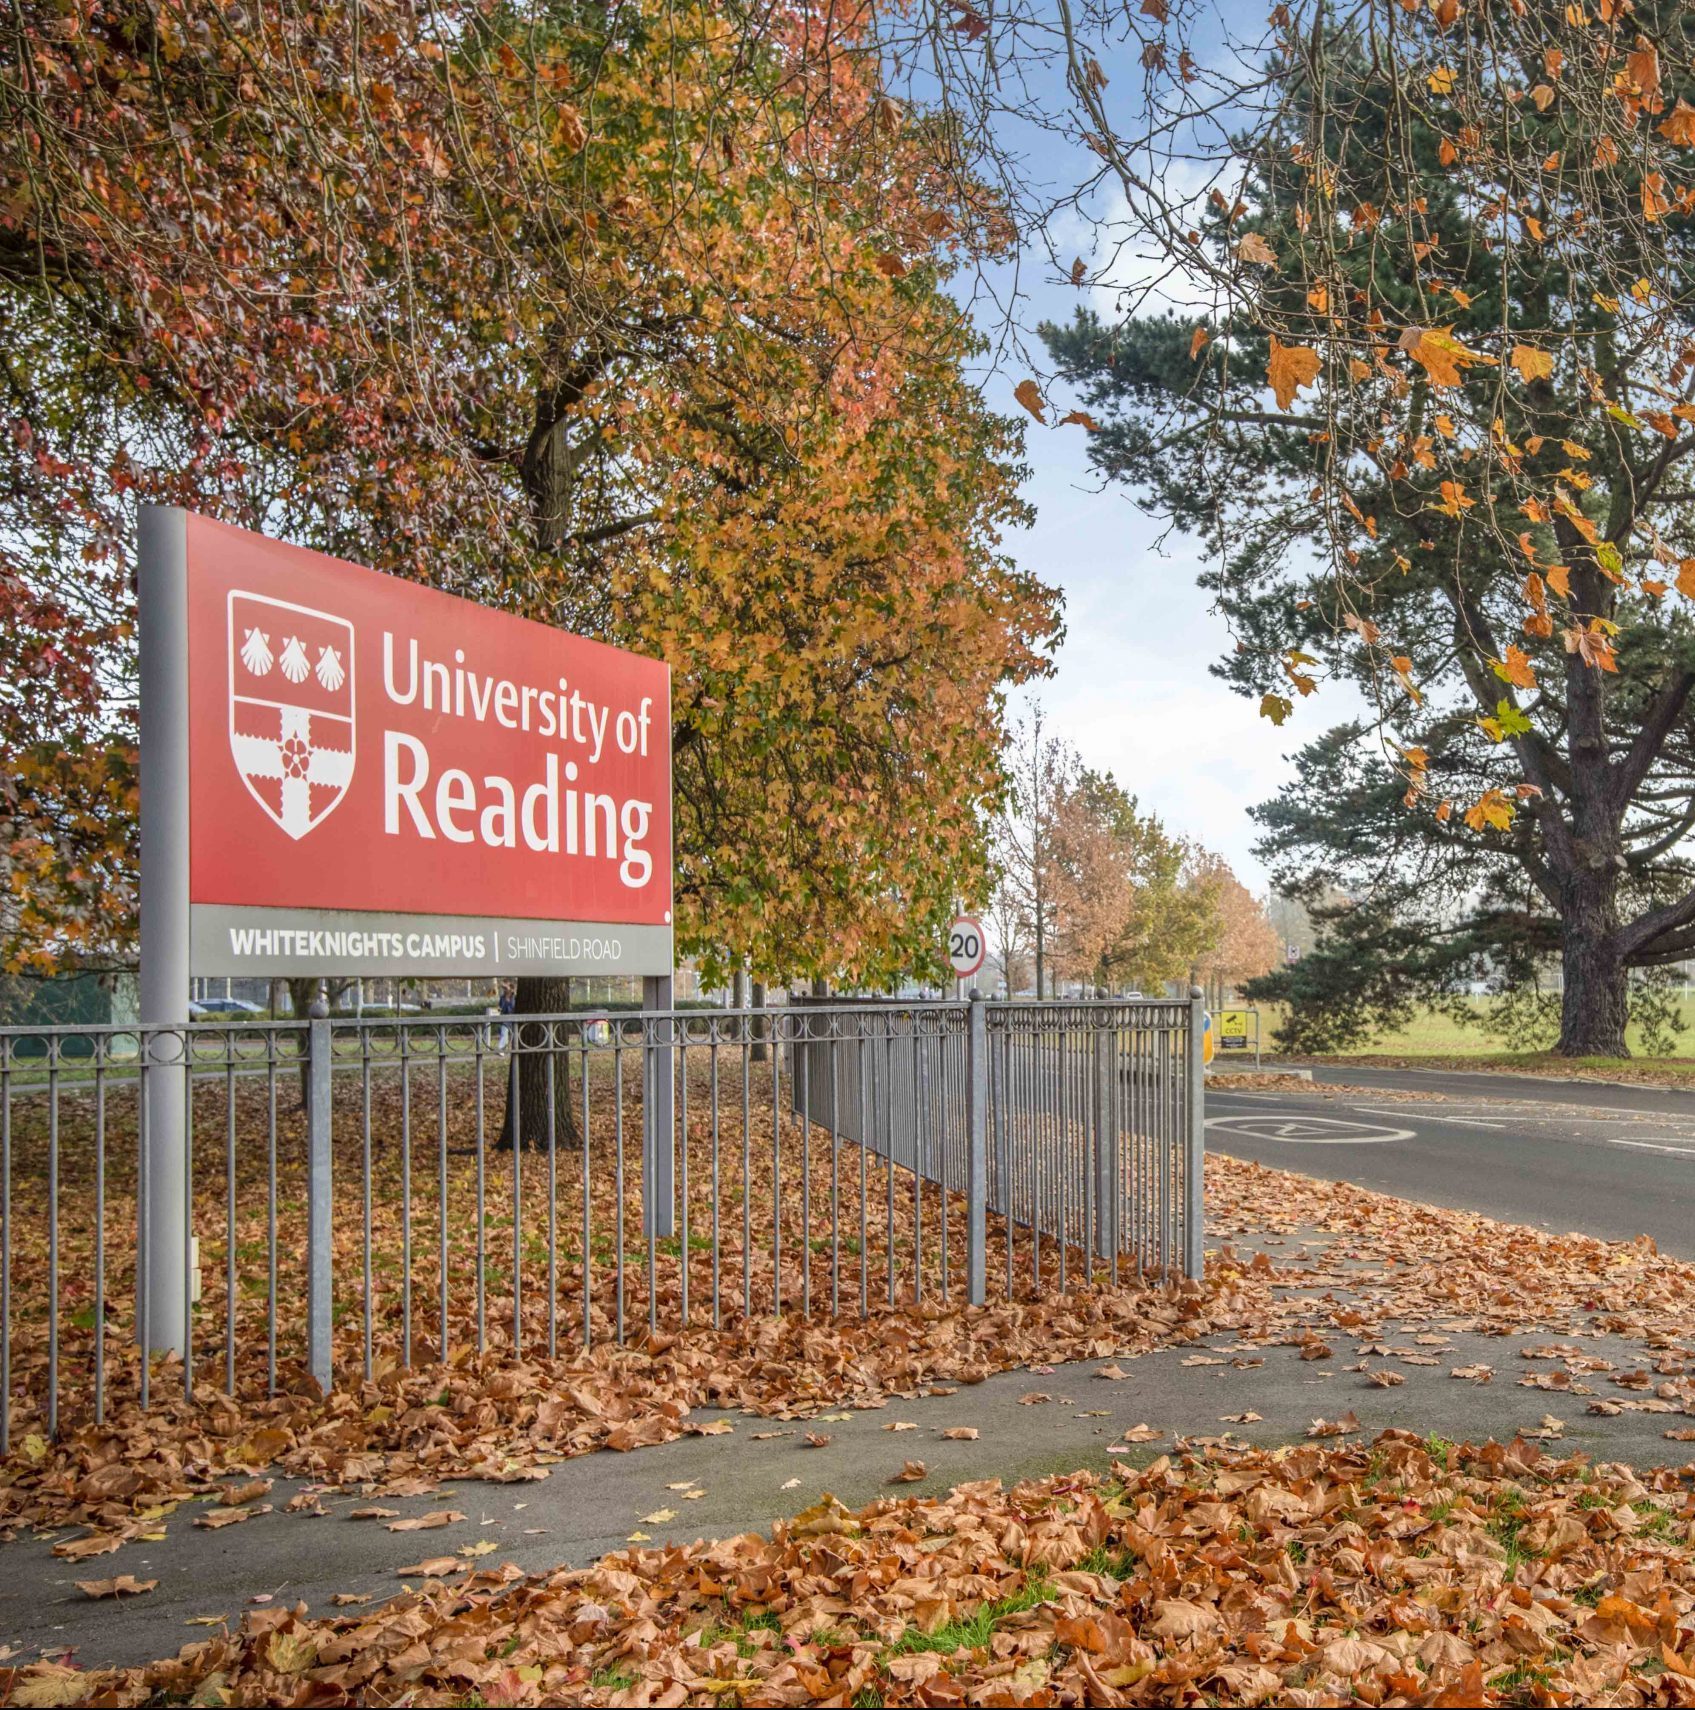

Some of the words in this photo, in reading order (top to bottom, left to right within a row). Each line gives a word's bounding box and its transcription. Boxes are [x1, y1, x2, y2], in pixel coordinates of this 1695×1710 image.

[383, 631, 609, 764] University
[615, 697, 653, 757] of
[383, 729, 654, 889] Reading
[229, 927, 404, 959] WHITEKNIGHTS
[406, 933, 486, 960] CAMPUS
[507, 936, 581, 960] SHINFIELD
[582, 938, 622, 961] ROAD
[950, 933, 979, 959] 20
